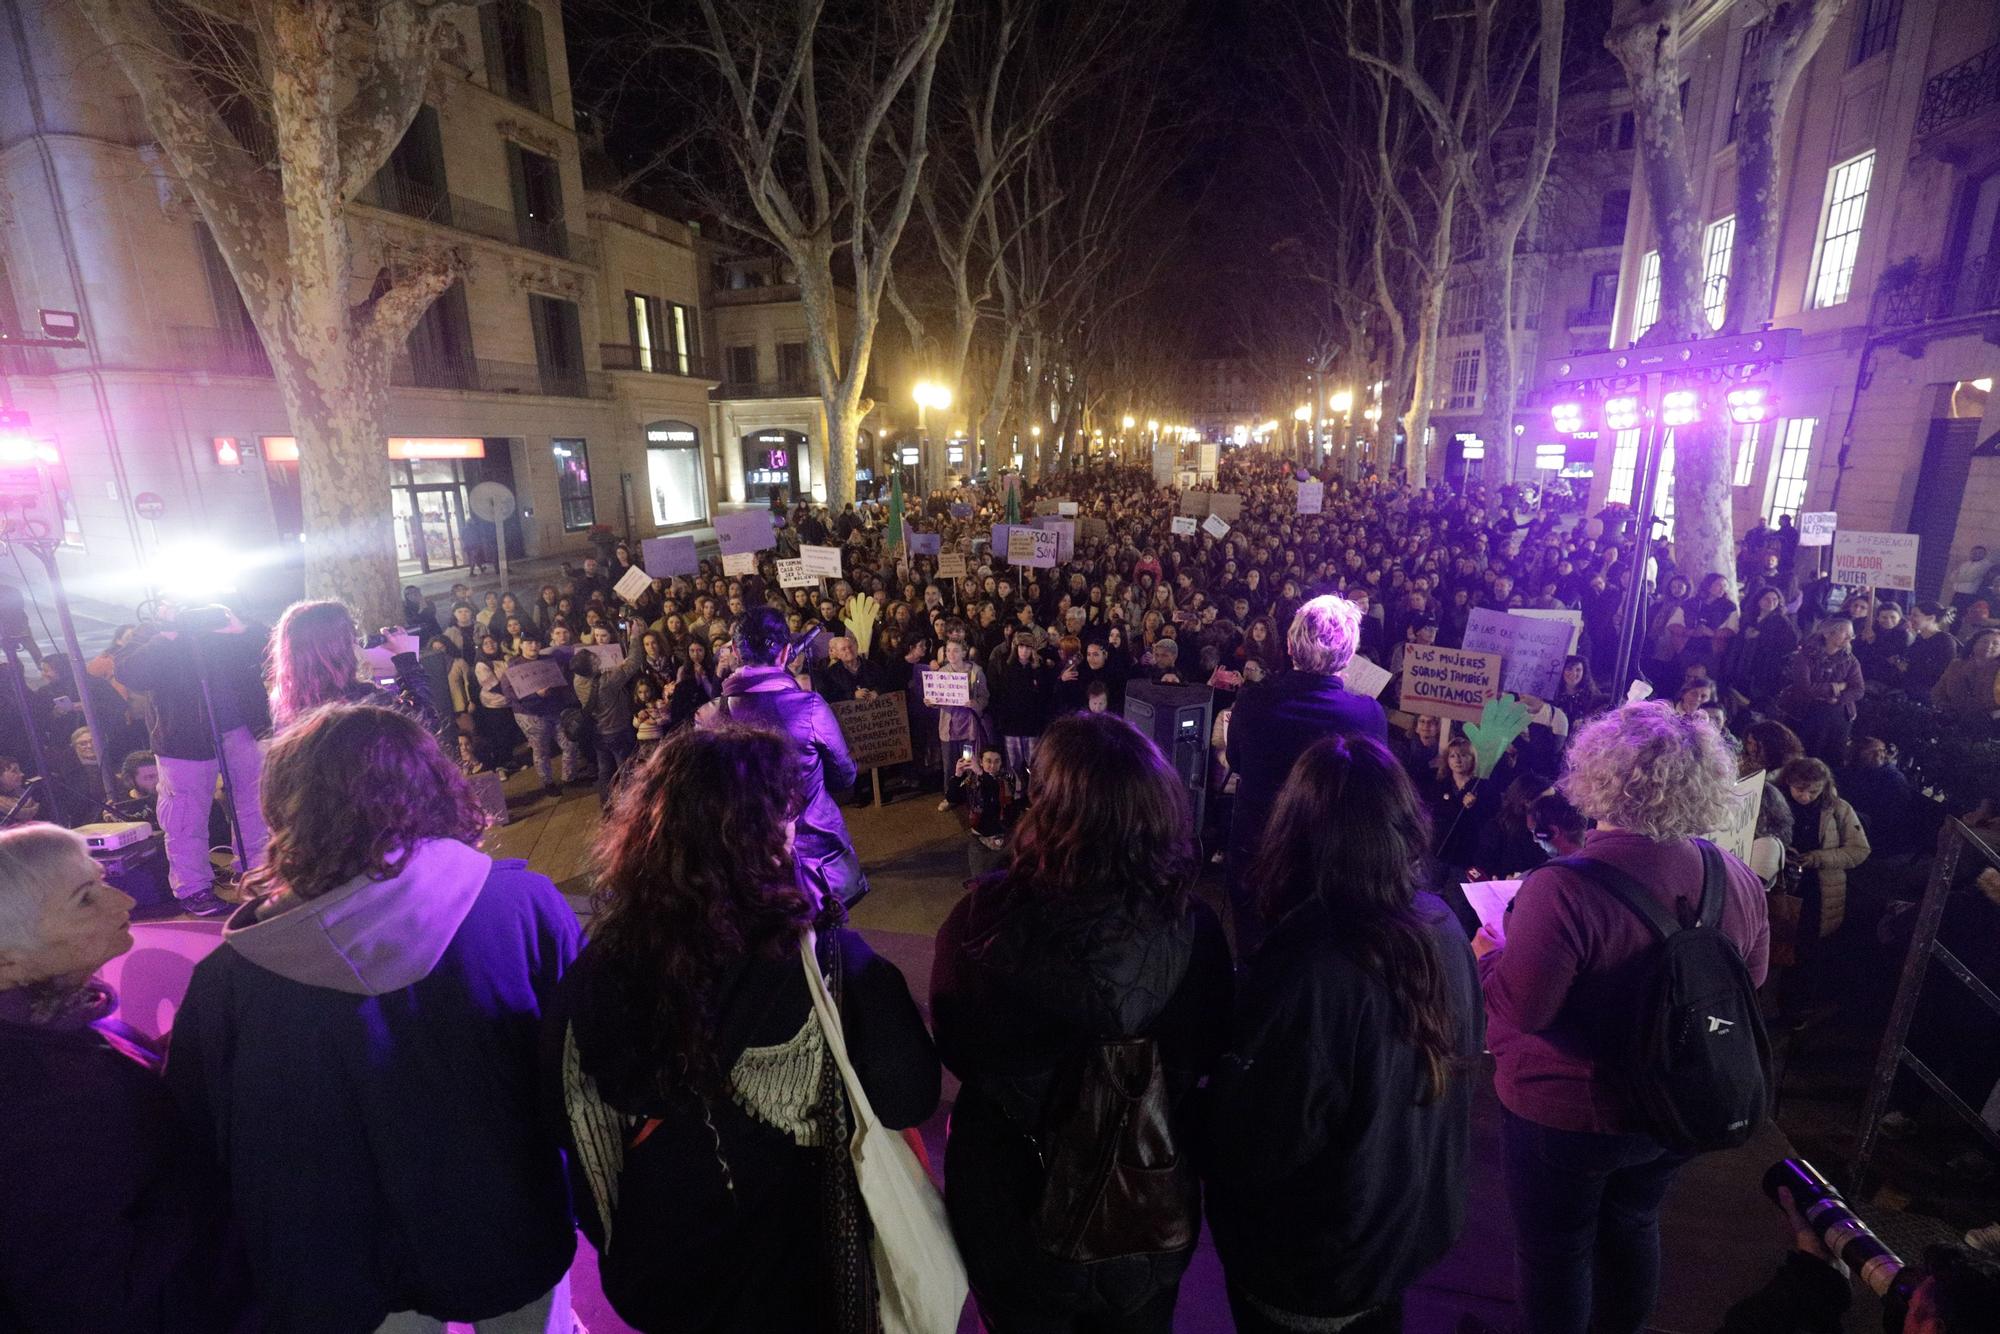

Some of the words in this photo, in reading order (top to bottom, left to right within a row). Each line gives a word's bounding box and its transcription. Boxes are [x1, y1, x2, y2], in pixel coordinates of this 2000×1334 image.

[1836, 554, 1882, 570] VIOLADOR
[1837, 571, 1867, 584] PUTER
[1481, 626, 1496, 634] LAS
[1415, 650, 1435, 662] LAS
[1439, 653, 1486, 670] MUJERES
[1410, 665, 1448, 681] SORDAS
[1414, 681, 1483, 703] CONTAMOS
